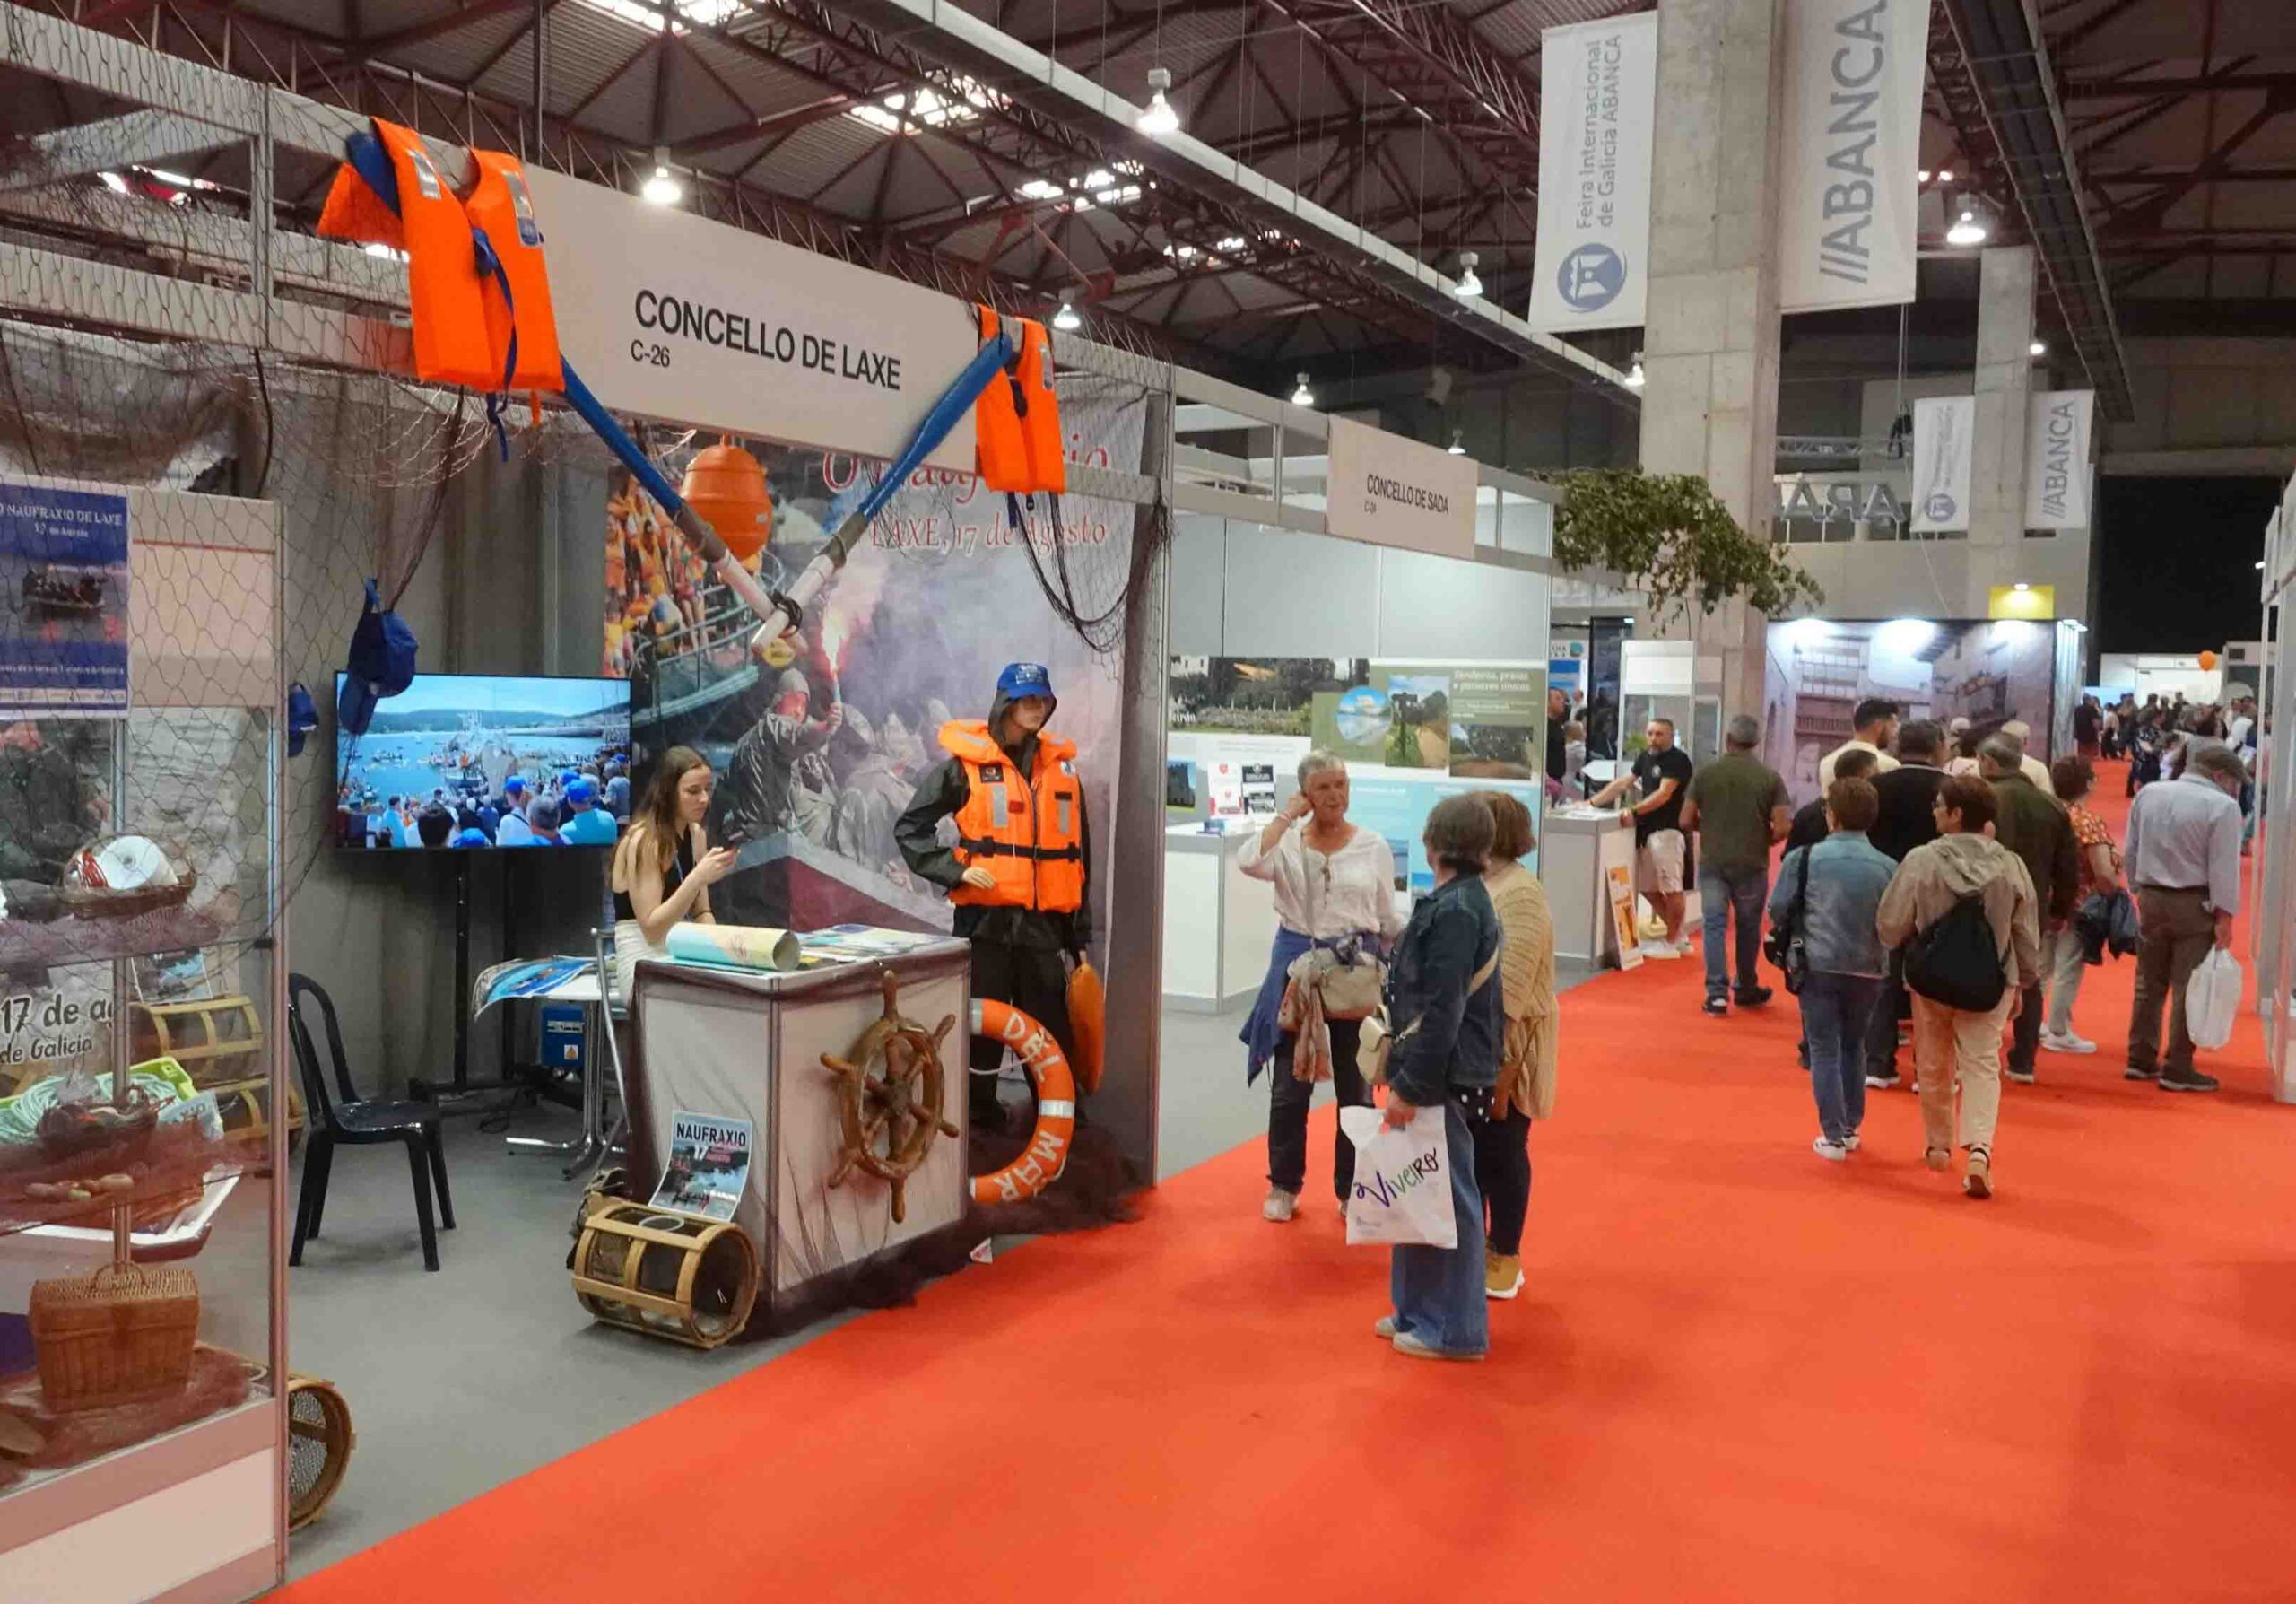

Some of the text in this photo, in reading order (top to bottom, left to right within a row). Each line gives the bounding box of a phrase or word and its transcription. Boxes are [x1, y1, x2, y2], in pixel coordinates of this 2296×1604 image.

[1576, 39, 1601, 230] Feira Internacional
[1596, 33, 1622, 228] de Galicia ABANCA
[630, 339, 671, 368] C-26
[634, 289, 901, 391] CONCELLO DE LAXE
[1366, 473, 1450, 517] CONCELLO DE SADA
[956, 526, 978, 555] 17
[986, 510, 1014, 546] de
[1, 997, 30, 1033] 17
[43, 993, 79, 1027] de
[0, 1034, 92, 1064] de Galicia
[675, 1122, 747, 1147] NAUFRAXIO
[692, 1144, 709, 1161] 17
